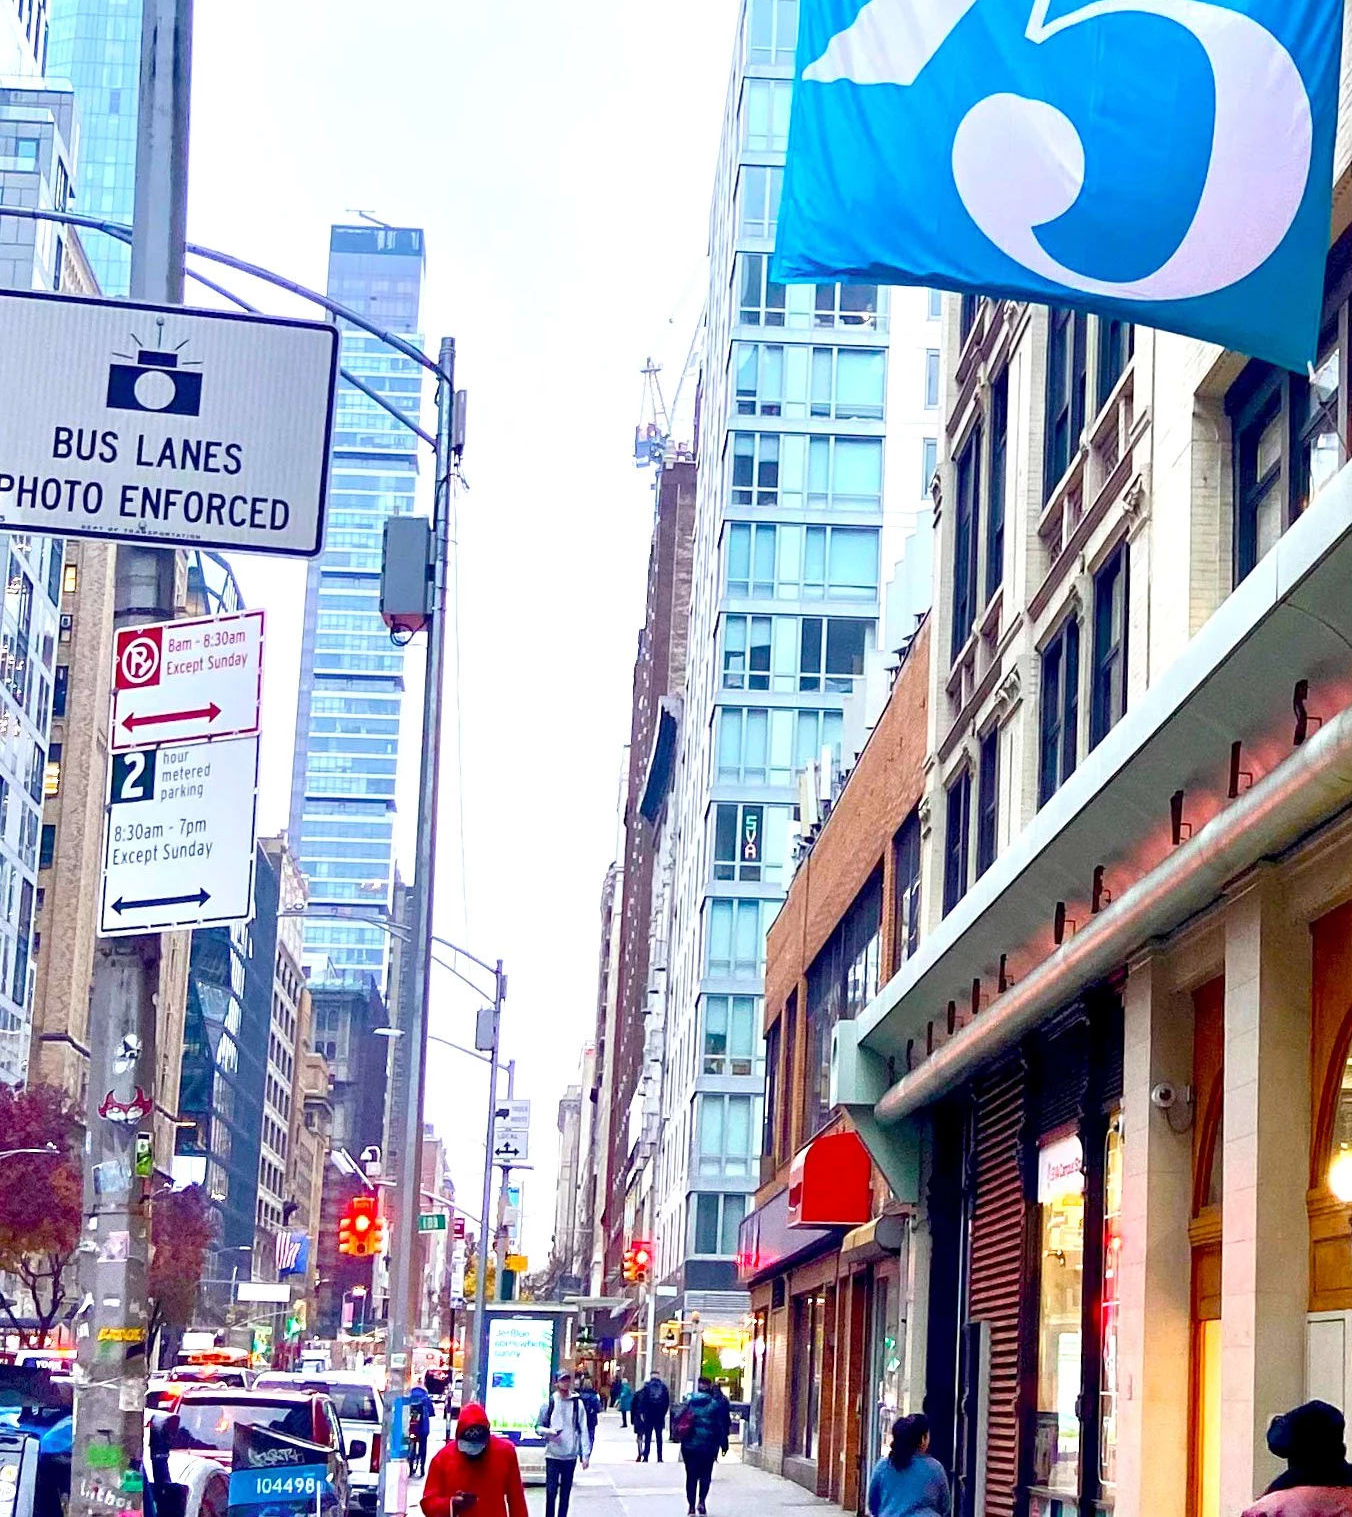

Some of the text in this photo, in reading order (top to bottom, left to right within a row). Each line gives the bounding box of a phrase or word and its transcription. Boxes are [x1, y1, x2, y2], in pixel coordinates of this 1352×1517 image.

[52, 426, 243, 475] BUS LANES
[0, 473, 290, 531] PHOTO ENFORCED
[168, 638, 192, 653] 8am
[203, 630, 246, 648] 8:30am
[166, 653, 248, 676] Except Sunday
[163, 750, 189, 765] hour
[120, 752, 146, 799] 2
[161, 763, 211, 782] metered
[160, 783, 204, 802] parking
[114, 823, 163, 843] 8:30am
[180, 818, 207, 838] 7pm
[744, 815, 758, 859] SVA
[112, 840, 213, 866] Except Sunday
[256, 1477, 316, 1495] 104498
